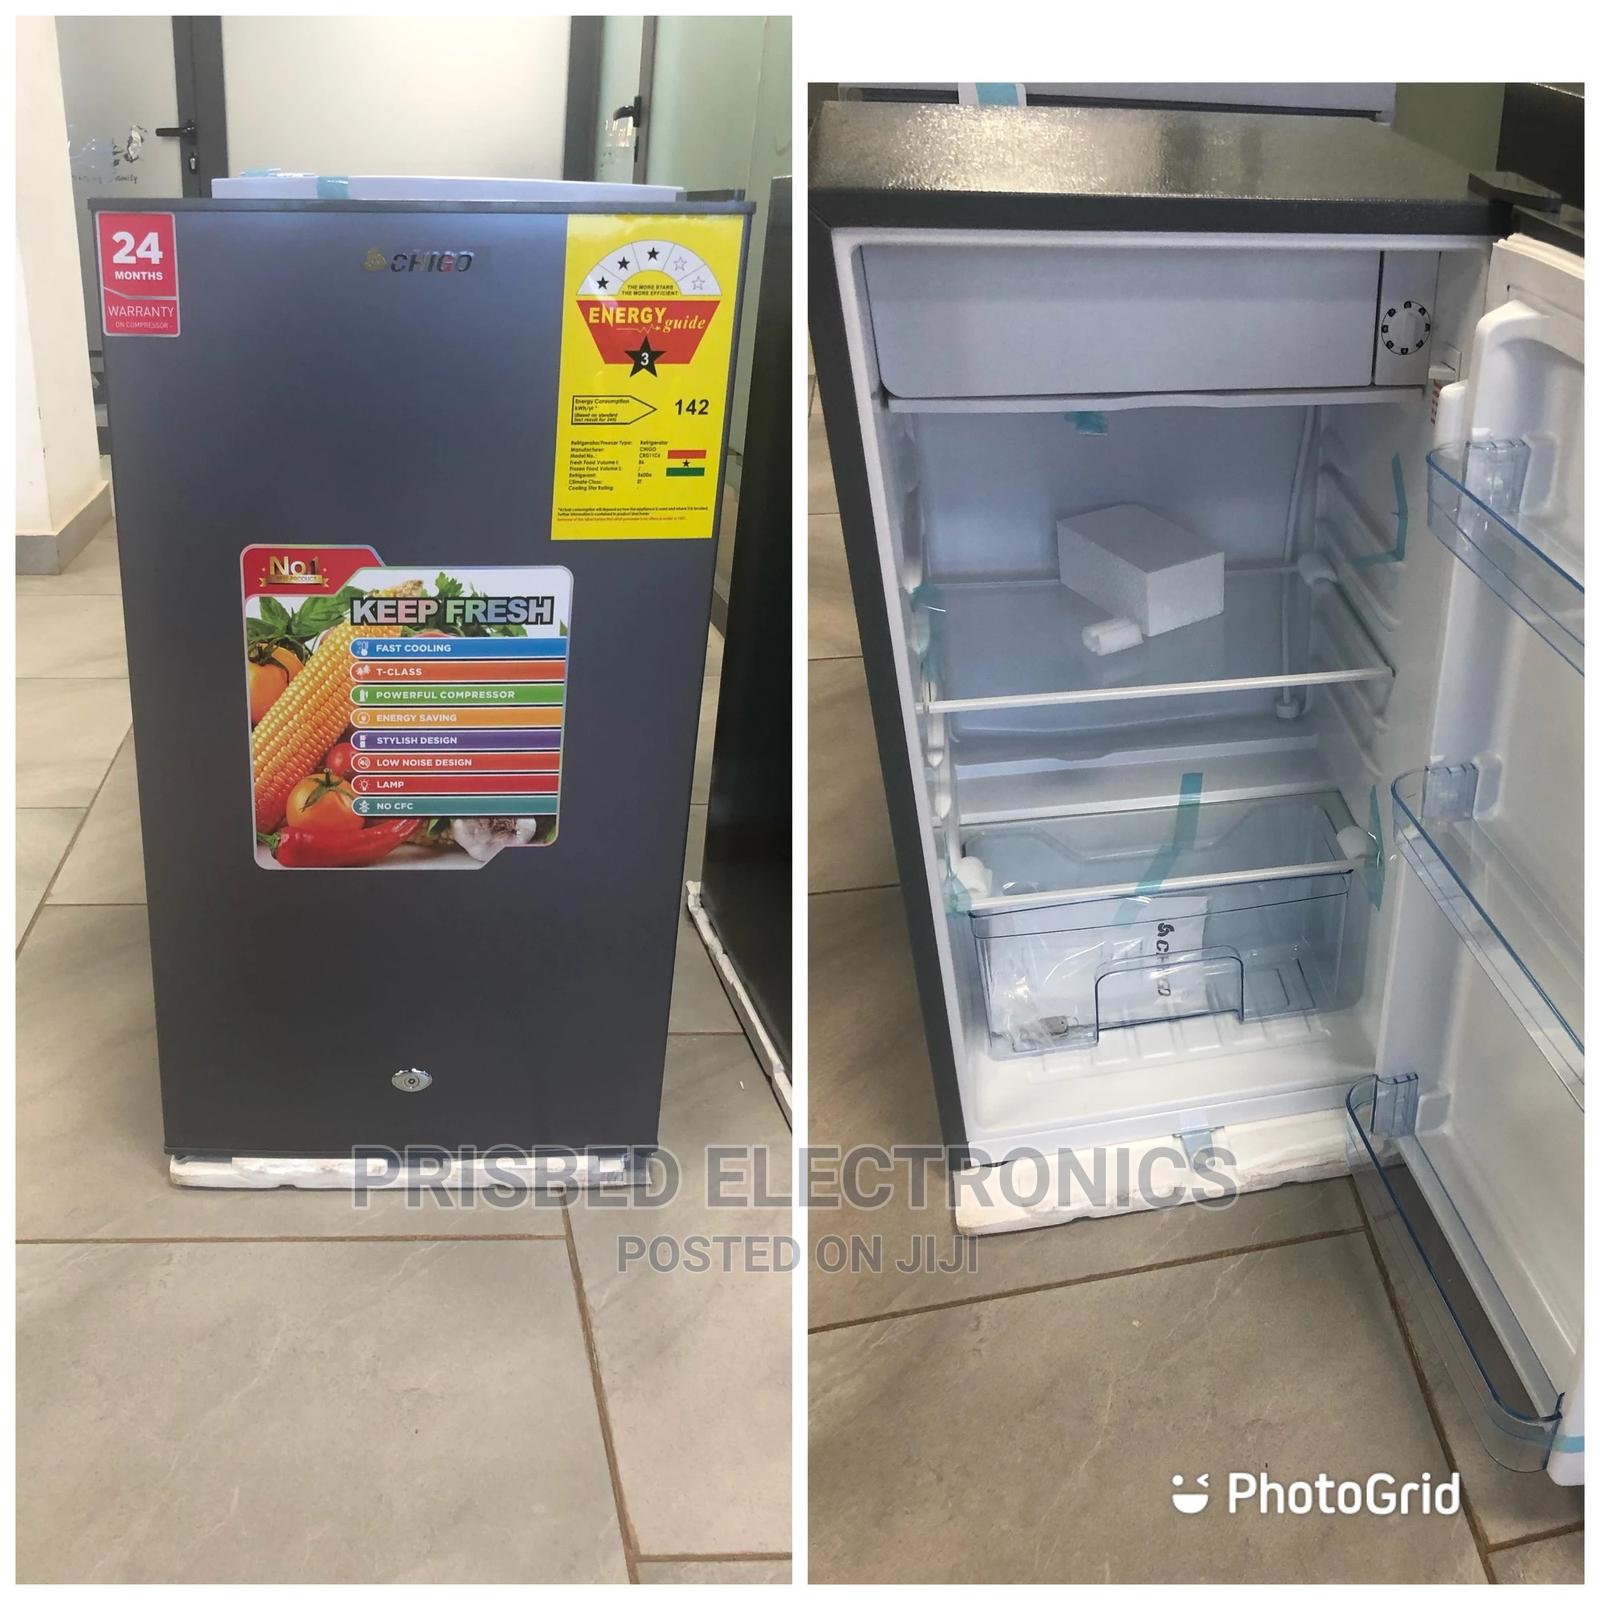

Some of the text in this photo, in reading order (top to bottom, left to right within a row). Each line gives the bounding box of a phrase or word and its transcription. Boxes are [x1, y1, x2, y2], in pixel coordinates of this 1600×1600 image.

[112, 231, 164, 265] 24
[115, 271, 164, 282] MONTHS
[107, 305, 176, 318] WARRANTY
[588, 305, 707, 334] ENERGY guide
[126, 321, 169, 329] COMPRESSOR
[640, 352, 650, 366] 3
[574, 398, 630, 406] Energy Consumption
[674, 399, 710, 415] 142
[349, 596, 554, 625] KEEP FRESH
[376, 644, 452, 653] FAST COOLING
[376, 667, 423, 677] T-CLASS
[376, 690, 516, 700] POWERFUL COMPRESSOR
[376, 713, 458, 723] ENERGY SAVING
[376, 736, 458, 745] STYLISH DESIGN
[376, 758, 473, 768] LOW NOISE DESIGN
[376, 780, 405, 789] LAMP
[376, 802, 414, 811] NO CFC
